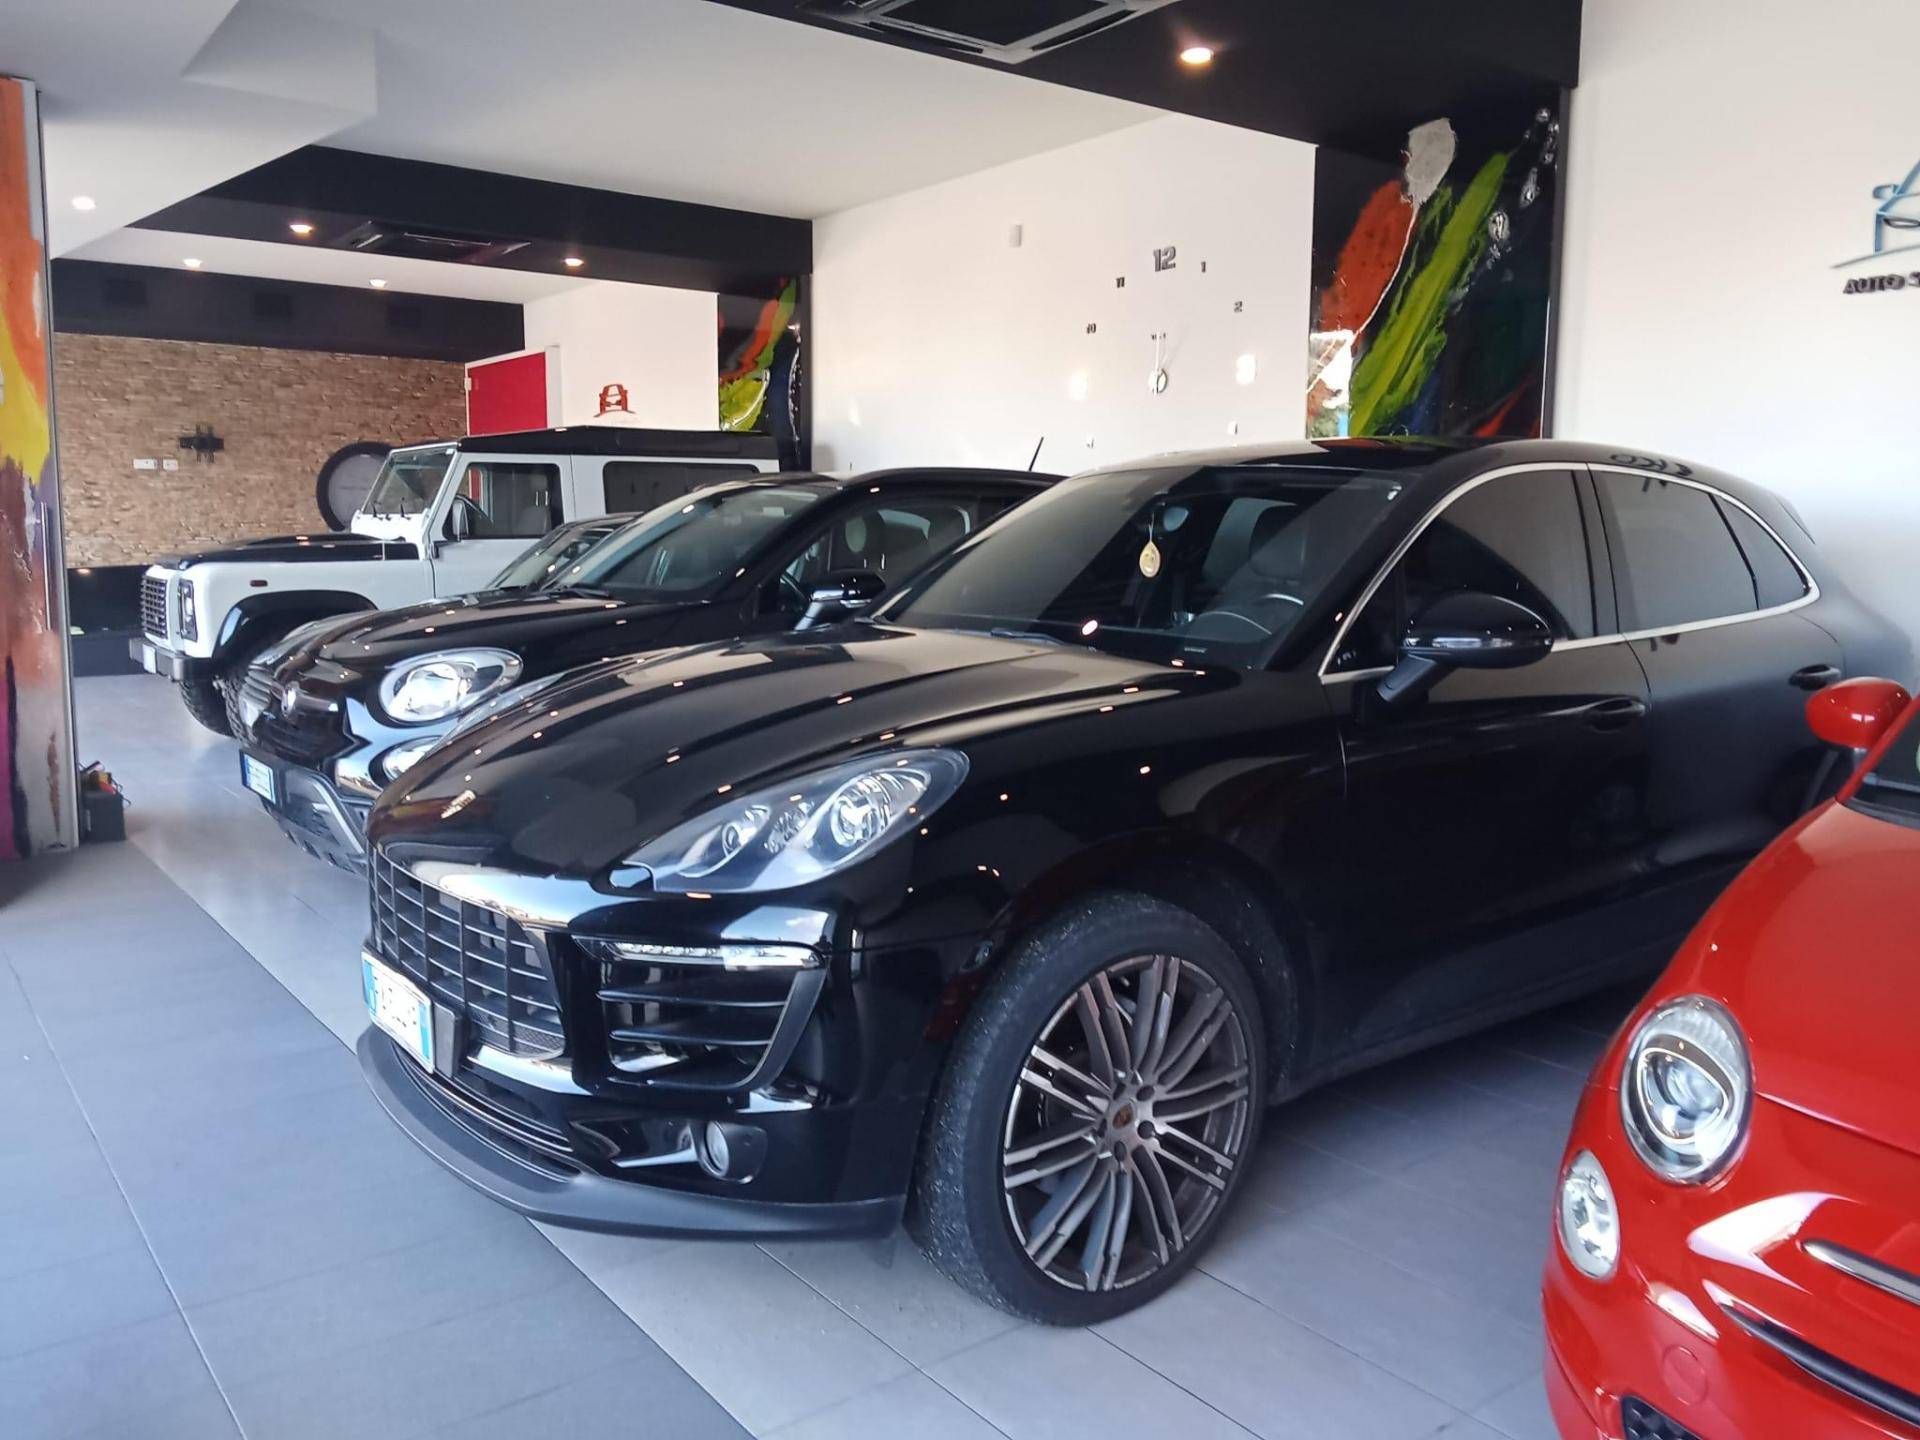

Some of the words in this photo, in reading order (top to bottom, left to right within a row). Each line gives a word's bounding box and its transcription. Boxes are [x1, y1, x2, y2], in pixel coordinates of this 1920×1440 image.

[1153, 246, 1177, 272] 12
[1201, 261, 1206, 273] 1
[1116, 277, 1125, 288] 11
[1843, 274, 1905, 294] AUTO
[1234, 301, 1243, 312] 2
[1086, 323, 1097, 334] 10
